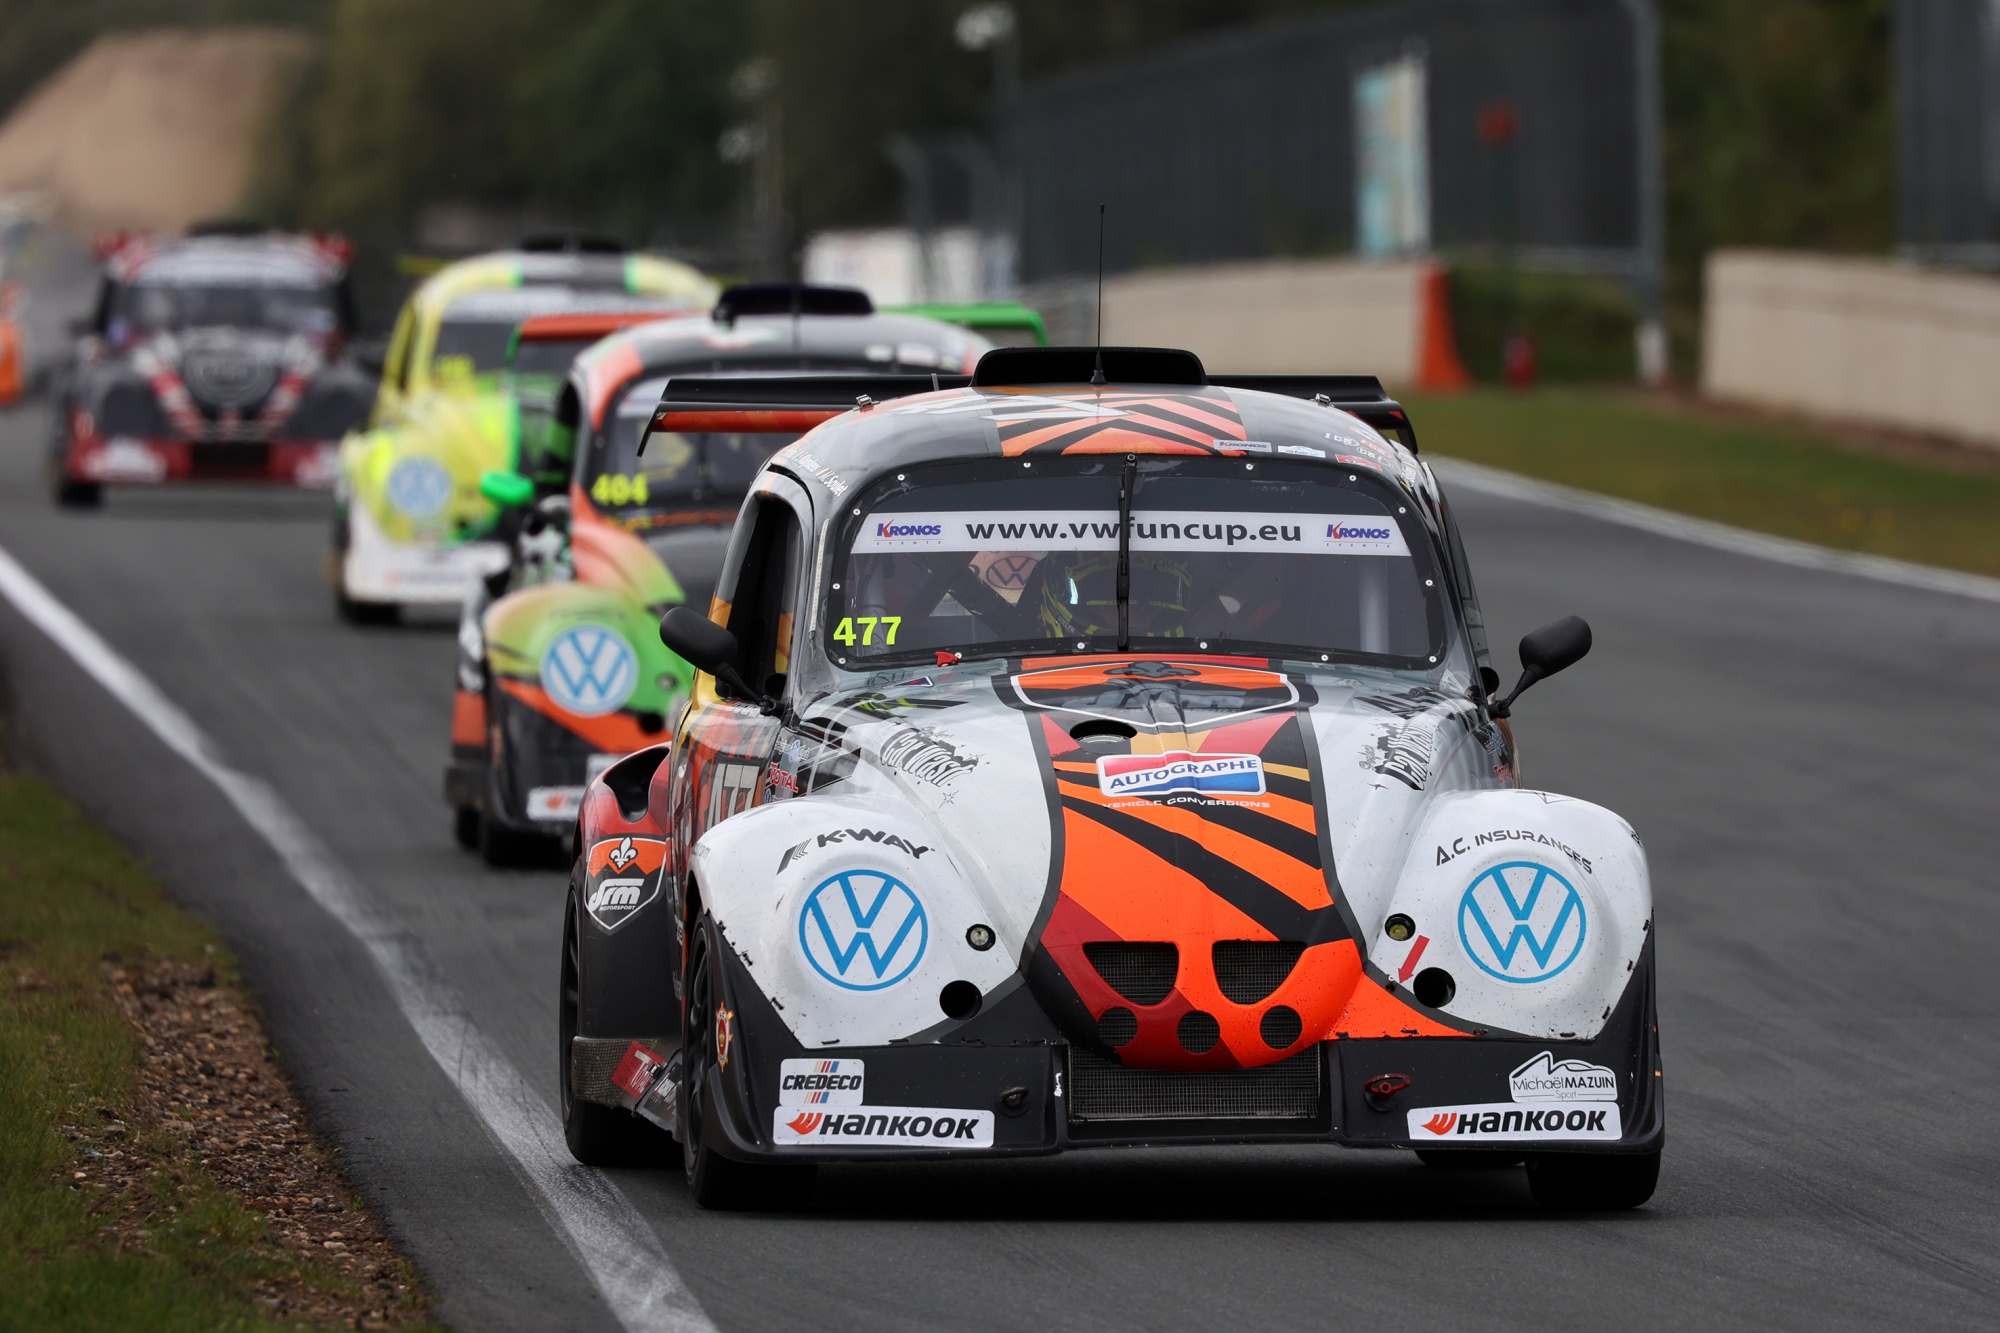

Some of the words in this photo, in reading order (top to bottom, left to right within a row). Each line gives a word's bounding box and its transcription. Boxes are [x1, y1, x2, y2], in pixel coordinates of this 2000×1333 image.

[592, 473, 648, 505] 404
[877, 519, 942, 538] KRONOS
[965, 516, 1302, 546] www.vwfuncup.eu
[1326, 521, 1391, 540] KRONOS
[833, 616, 902, 646] 477
[770, 761, 799, 794] TOTAL
[1110, 759, 1258, 790] AUTOGRAPHE
[1101, 799, 1163, 809] VEHICLE
[1167, 796, 1271, 809] CONVERSIONS
[1474, 829, 1593, 875] INSURANCES
[782, 1074, 863, 1090] CREDECO
[1555, 1090, 1578, 1100] Sport
